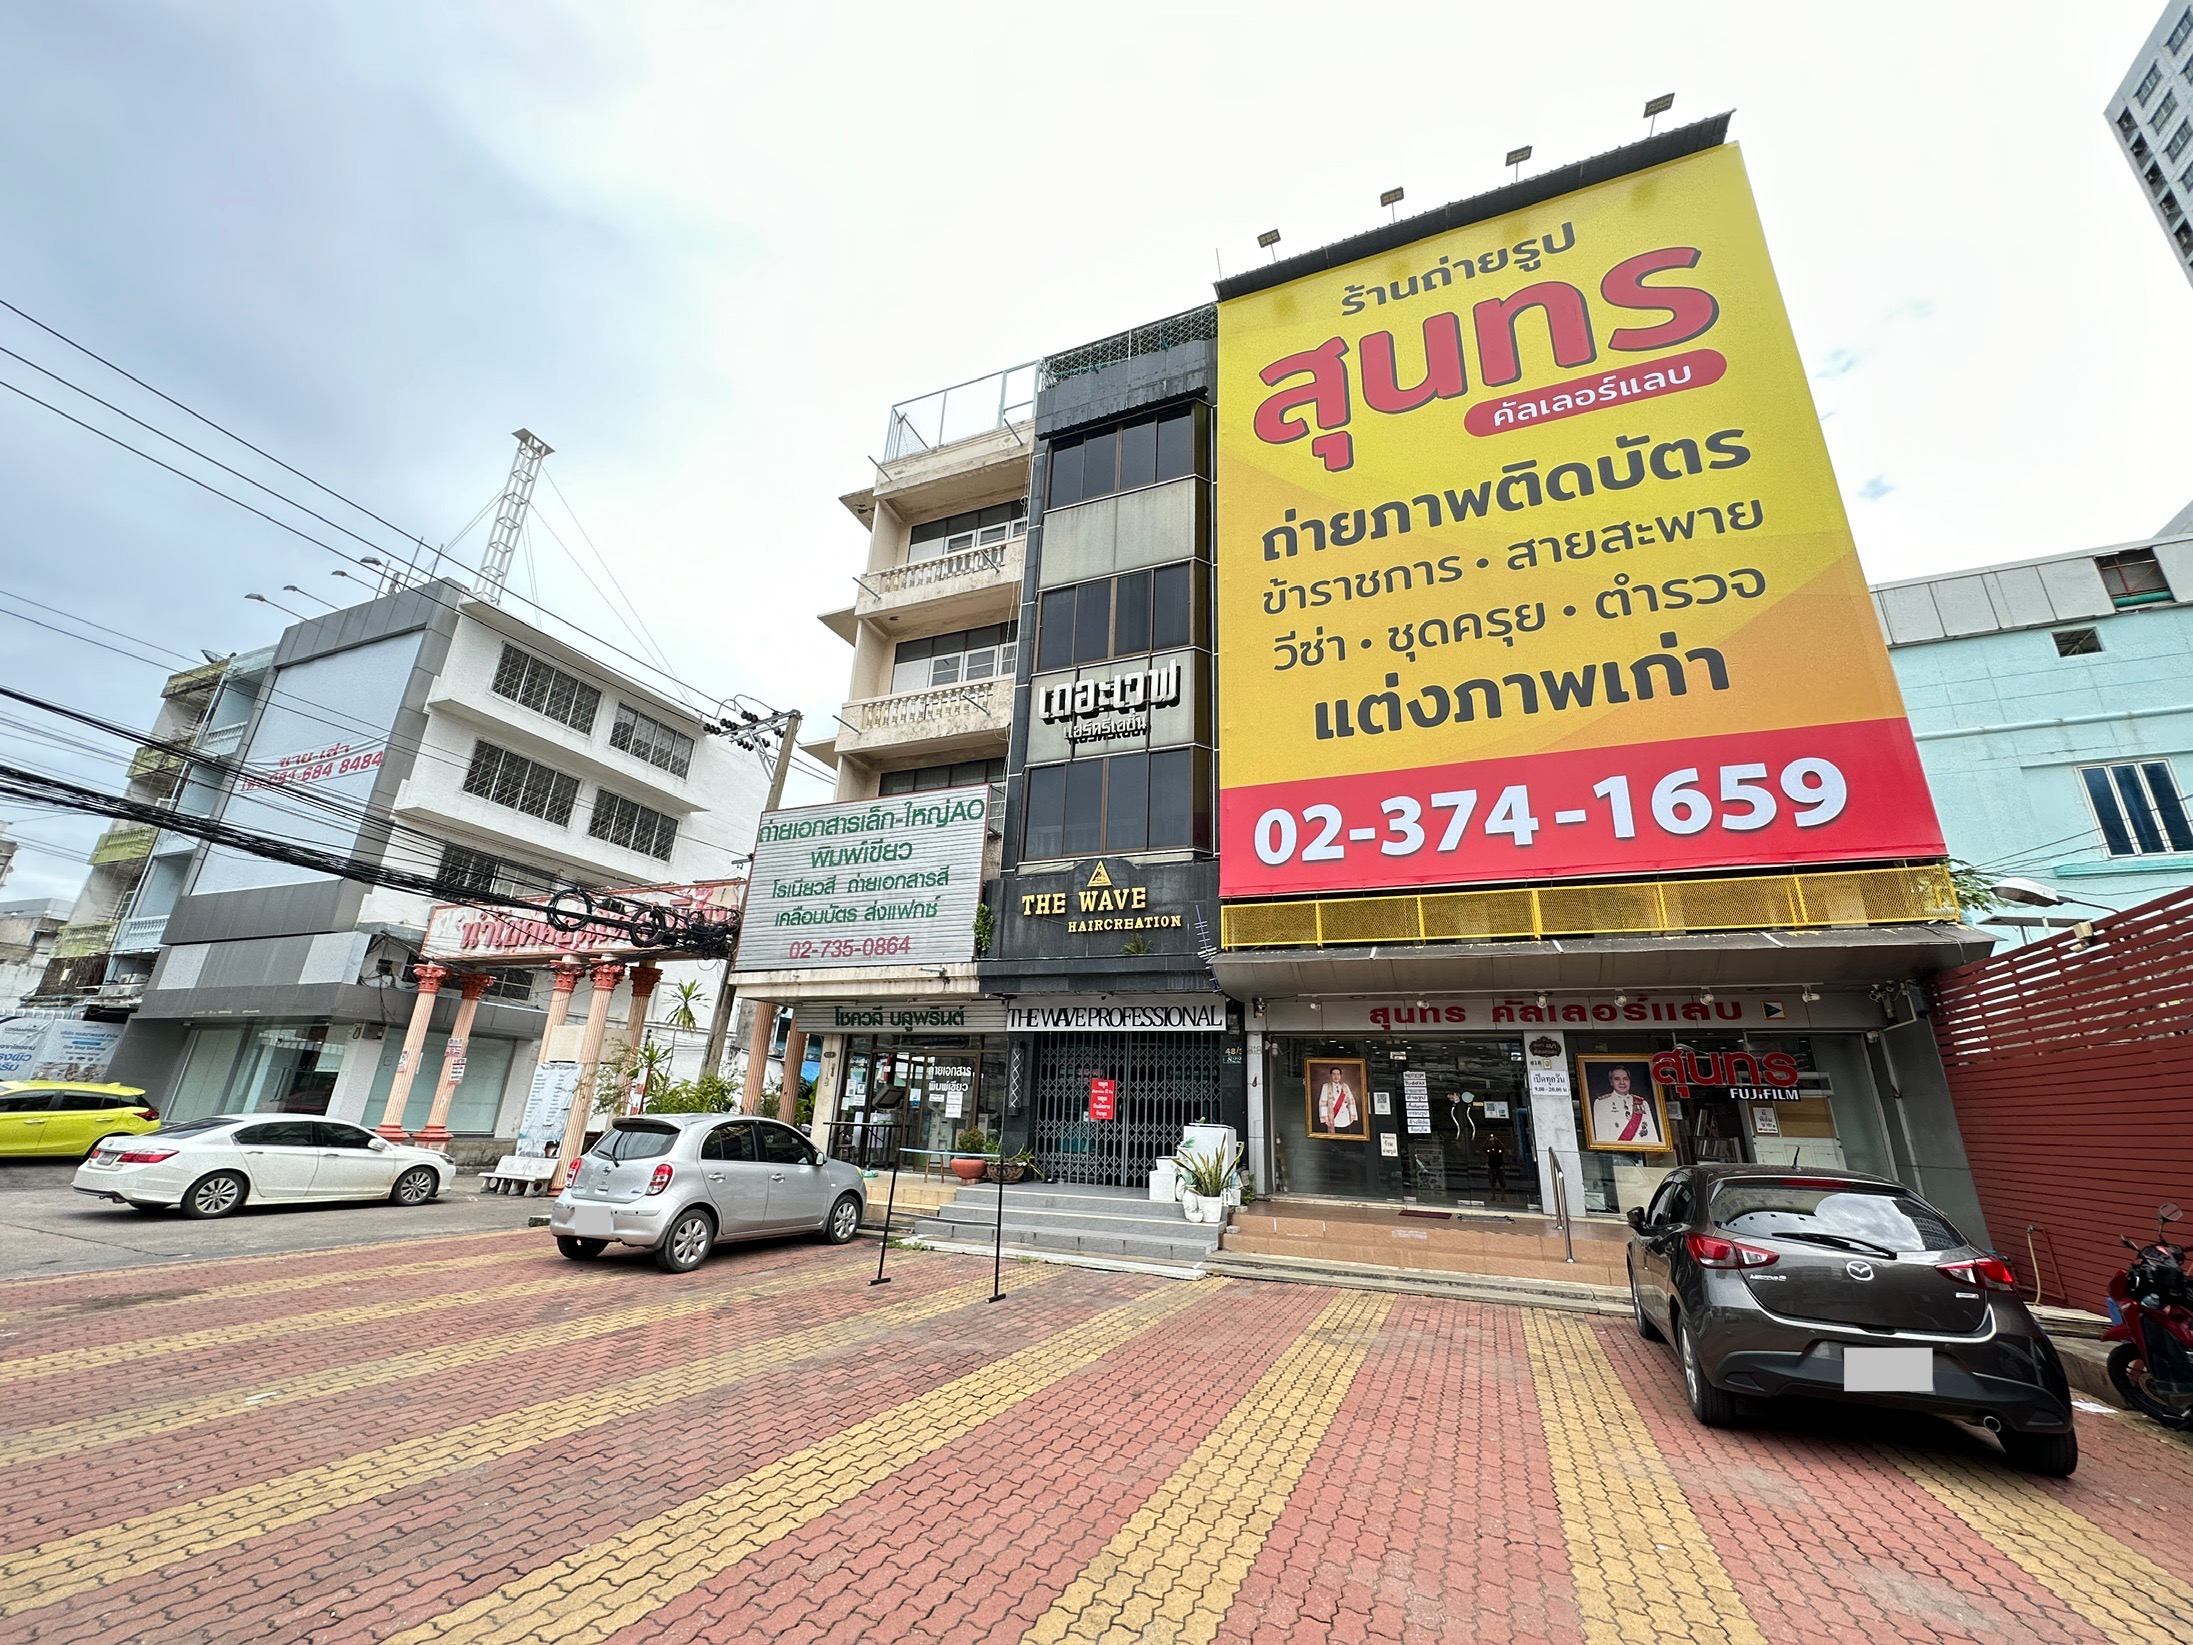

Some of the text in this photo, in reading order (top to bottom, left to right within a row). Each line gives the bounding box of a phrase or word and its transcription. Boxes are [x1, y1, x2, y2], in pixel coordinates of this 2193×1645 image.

[1341, 222, 1576, 316] ร้านถ่ายรูป
[1253, 247, 1720, 473] สุนทร
[1494, 364, 1692, 427] คัลเลอร์แลบ
[1262, 428, 1752, 561] ถ่ายภาพติดบัตร
[1262, 499, 1765, 615] ข้าราชการ สายสะพาย
[1273, 567, 1767, 671] วีซ่า ชุดครุย ตำรวจ
[1314, 632, 1730, 741] แต่งภาพเก่า
[338, 751, 384, 774] 8484
[1254, 757, 1848, 866] 02-374-1659
[811, 838, 913, 868] พิมพ์เขียว
[772, 865, 950, 899] โรเนียวสี ถ่ายเอกสารสี
[774, 896, 941, 927] เคลือบบัตร ส่งแฟกซ์
[1022, 887, 1147, 916] THE WAVE
[1068, 915, 1182, 933] HAIRCREATION
[789, 936, 911, 959] 02-735-0864
[1007, 1005, 1223, 1028] THE WAVE PROFESSIONAL
[1369, 996, 1743, 1030] สุนทร คัลเลอร์แลบ
[928, 1063, 972, 1077] ถ่ายเอกสาร
[928, 1080, 969, 1092] พิมพ์เขียว
[1533, 1073, 1565, 1086] เปิดทุกวัน
[1651, 1048, 1799, 1099] สุนทร
